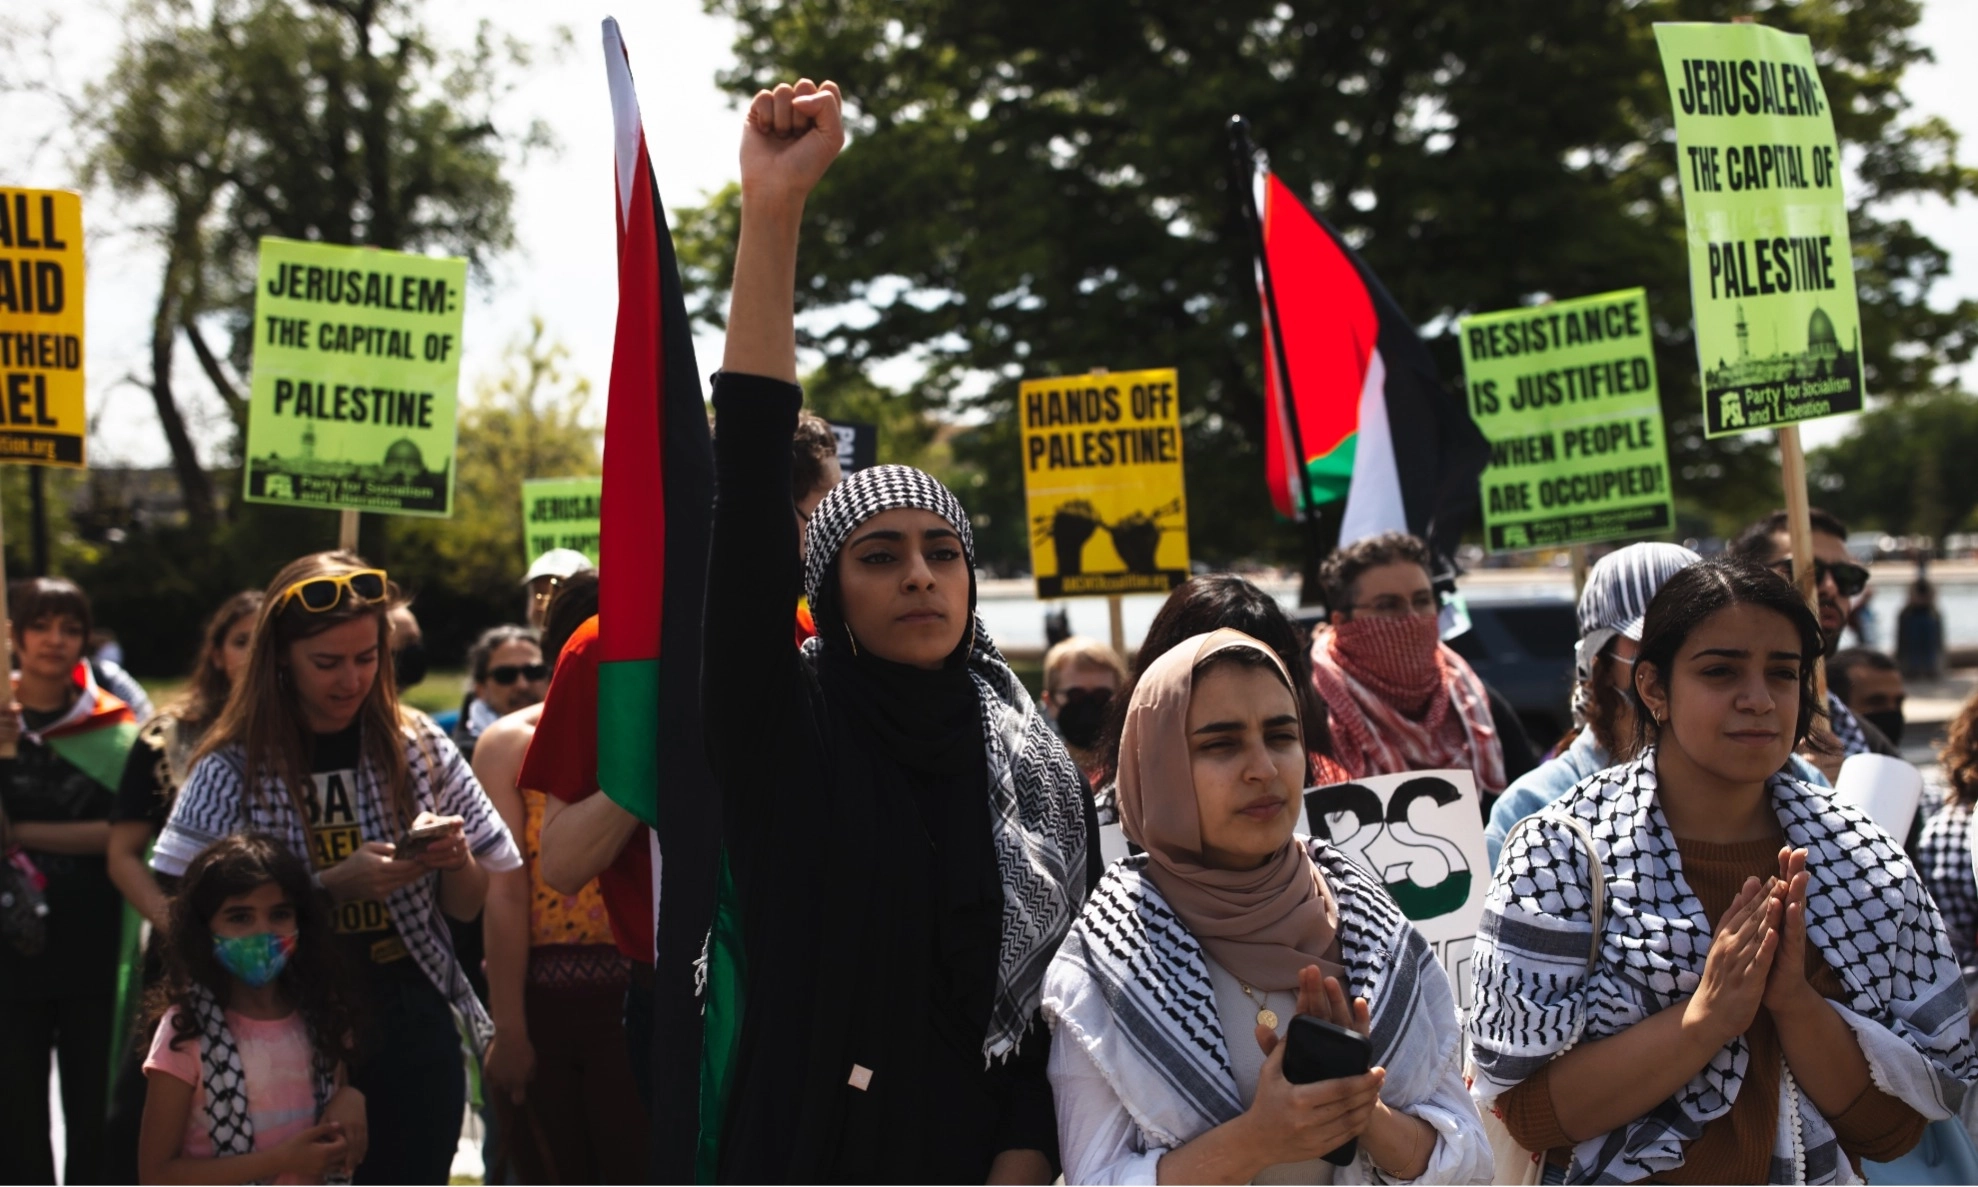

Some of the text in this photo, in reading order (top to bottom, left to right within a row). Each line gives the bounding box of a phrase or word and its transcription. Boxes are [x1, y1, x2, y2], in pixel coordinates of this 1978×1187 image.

[1678, 59, 1824, 116] JERUSALEM:
[1687, 144, 1834, 193] THE CAPITAL OF
[267, 262, 457, 316] JERUSALEM:
[1708, 236, 1836, 300] PALESTINE
[265, 315, 455, 363] THE CAPITAL OF
[1468, 301, 1643, 362] RESISTANCE
[273, 378, 434, 429] PALESTINE
[1026, 382, 1173, 429] HANDS OFF
[1472, 356, 1651, 417] IS JUSTIFIED
[1745, 377, 1852, 406] Party for Socialism
[1748, 400, 1831, 424] and Liberation
[1029, 425, 1178, 472] PALESTINE!
[1491, 417, 1654, 469] WHEN PEOPLE
[1489, 463, 1665, 515] ARE OCCUPIED!
